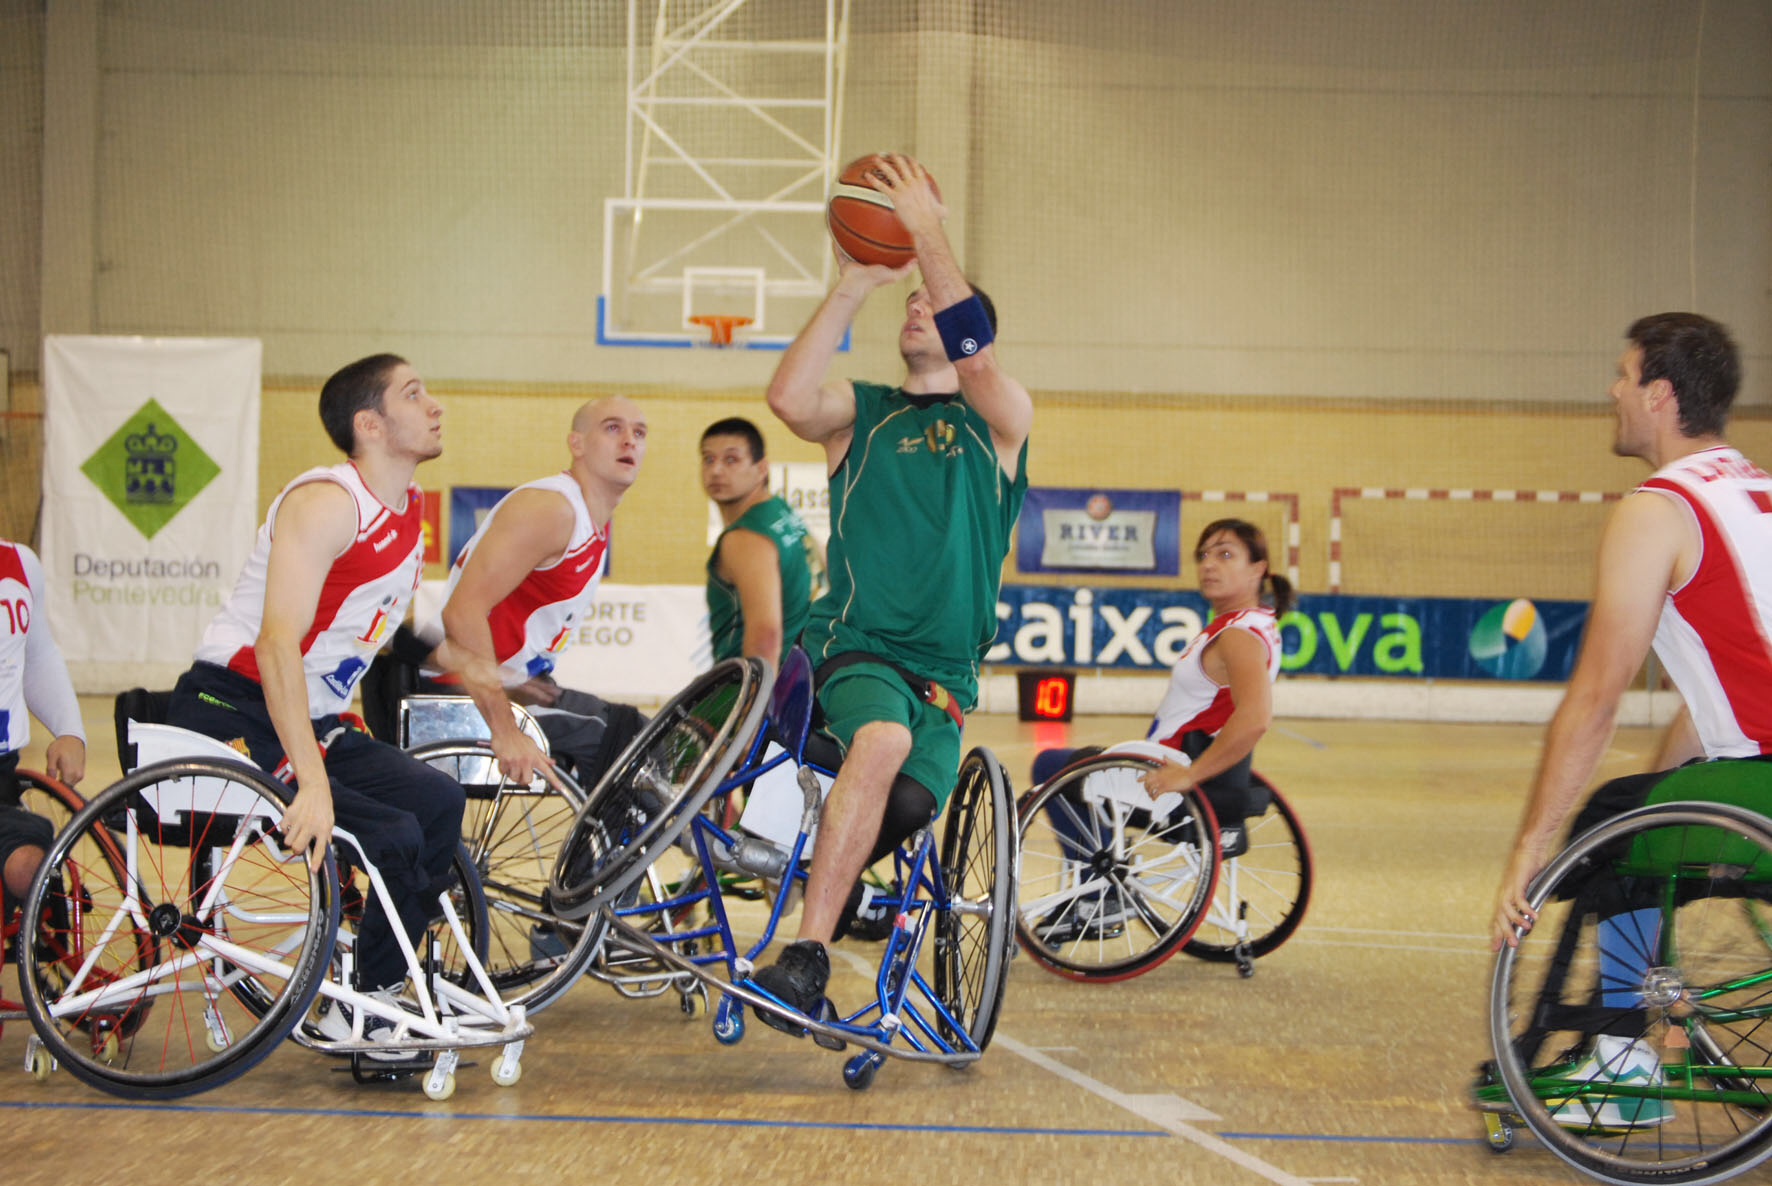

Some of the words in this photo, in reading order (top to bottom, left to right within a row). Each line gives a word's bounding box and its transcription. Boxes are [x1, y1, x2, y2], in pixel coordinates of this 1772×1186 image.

[1060, 523, 1138, 541] RIVER
[74, 553, 220, 581] Deputación
[73, 580, 221, 606] Pontevedra
[584, 602, 647, 621] ORTE
[1036, 678, 1068, 718] 10
